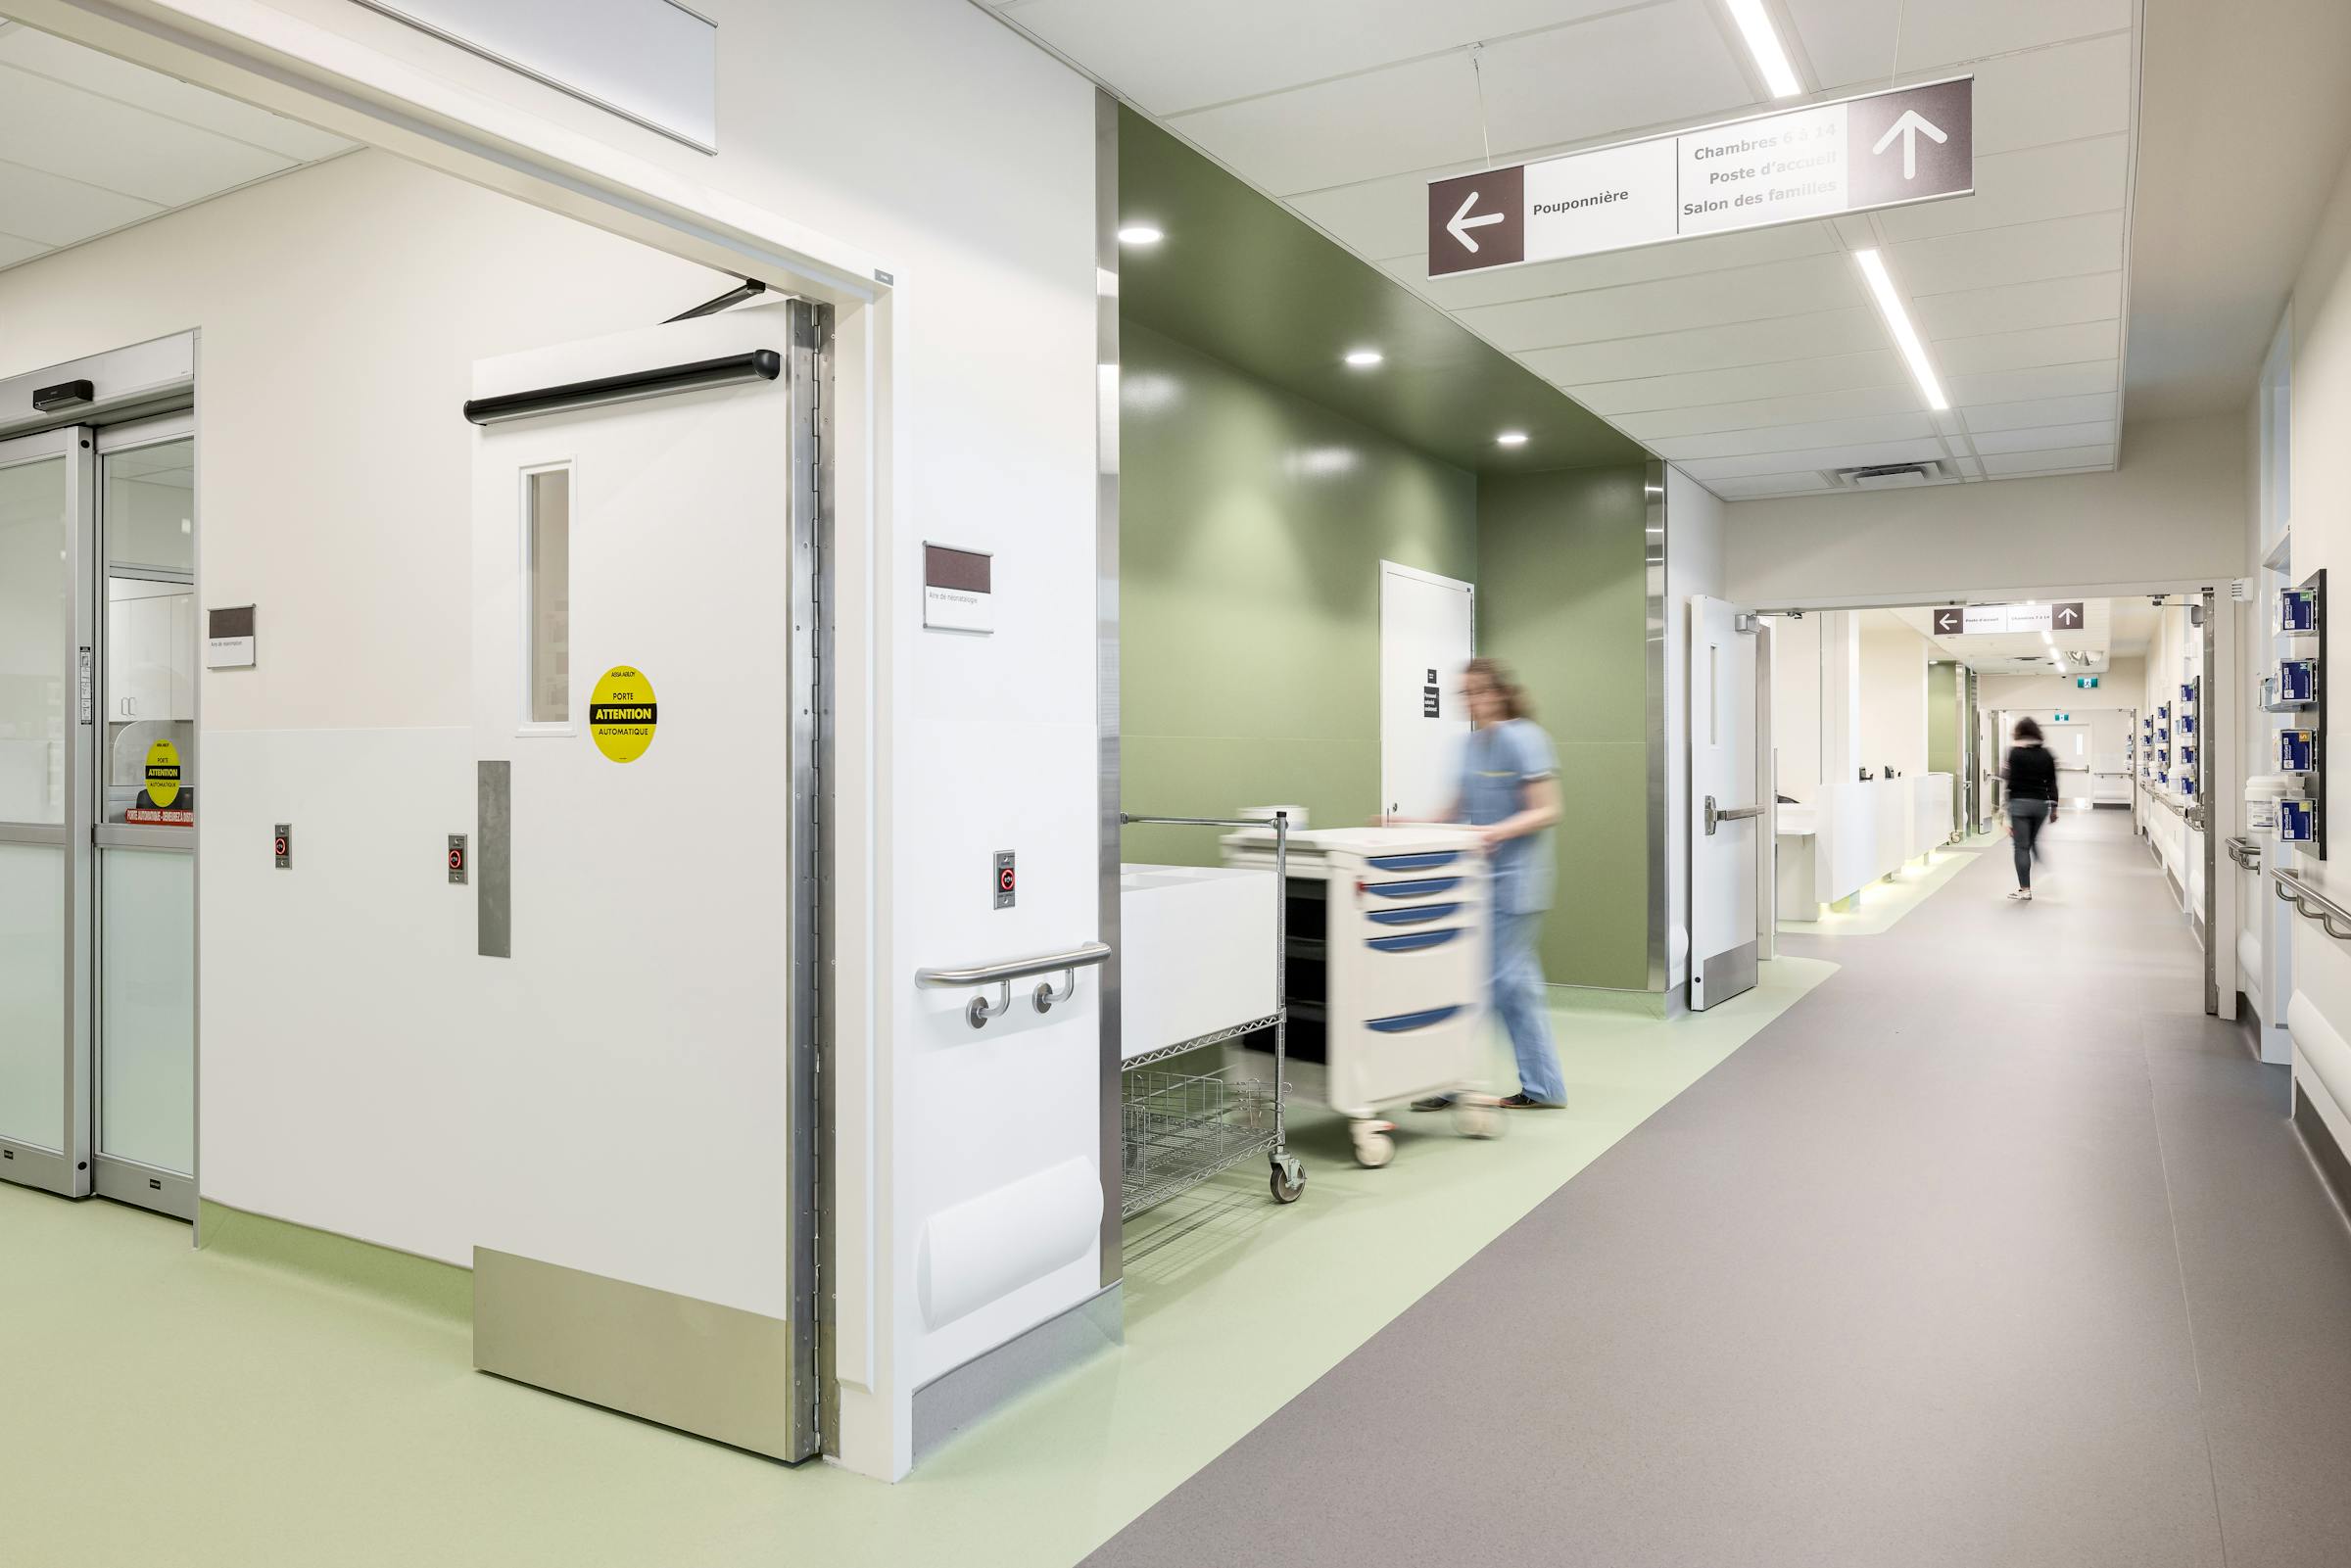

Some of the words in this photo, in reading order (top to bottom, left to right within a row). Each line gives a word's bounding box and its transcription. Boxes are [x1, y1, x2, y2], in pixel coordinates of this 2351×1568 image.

[1694, 136, 1777, 160] Chambres
[1783, 131, 1793, 144] 6
[1815, 123, 1837, 139] 14
[1709, 166, 1755, 184] Poste
[1533, 189, 1629, 215] Pouponnière
[1683, 200, 1729, 215] Salon
[1734, 194, 1763, 208] des
[1768, 180, 1838, 202] familles
[595, 708, 652, 720] ATTENTION
[148, 768, 178, 777] ATTENTION
